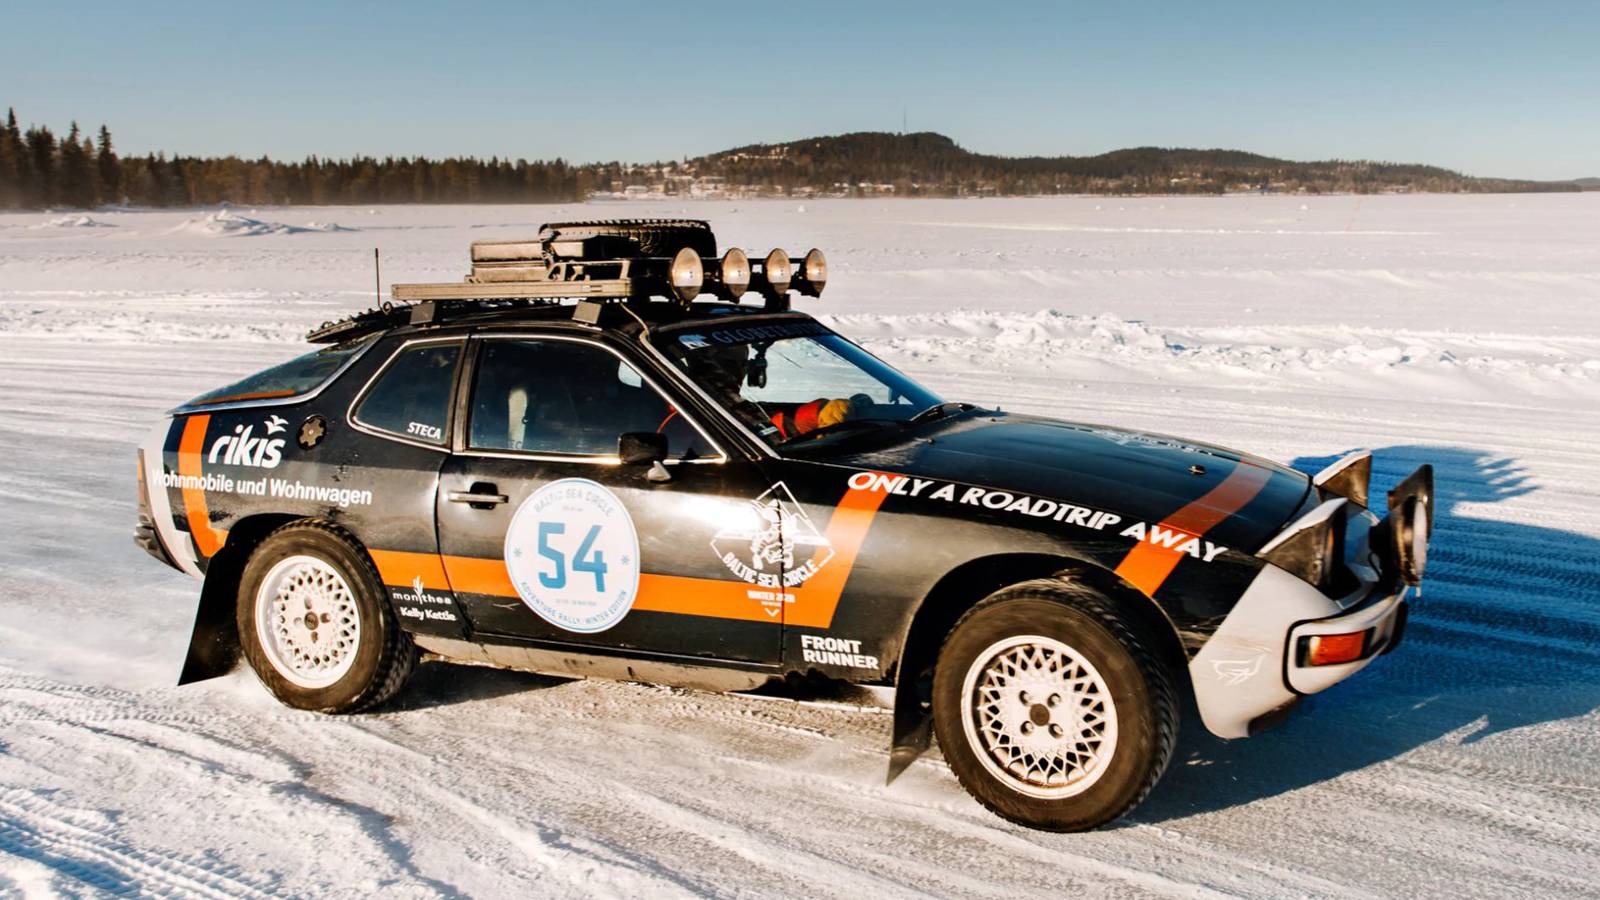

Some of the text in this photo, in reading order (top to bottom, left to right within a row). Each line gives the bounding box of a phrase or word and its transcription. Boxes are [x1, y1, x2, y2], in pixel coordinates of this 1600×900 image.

[208, 424, 286, 469] rikis
[407, 421, 441, 440] STECA
[150, 467, 373, 508] Wohnmobile und Wohnwagen
[847, 471, 1229, 563] ONLY A ROADTRIP AWAY
[538, 521, 608, 593] 54
[722, 552, 819, 588] BALTIC SEA CIRCLE
[400, 606, 457, 621] Kelly Kettle
[801, 634, 862, 654] FRONT
[803, 649, 880, 670] RUNNER
